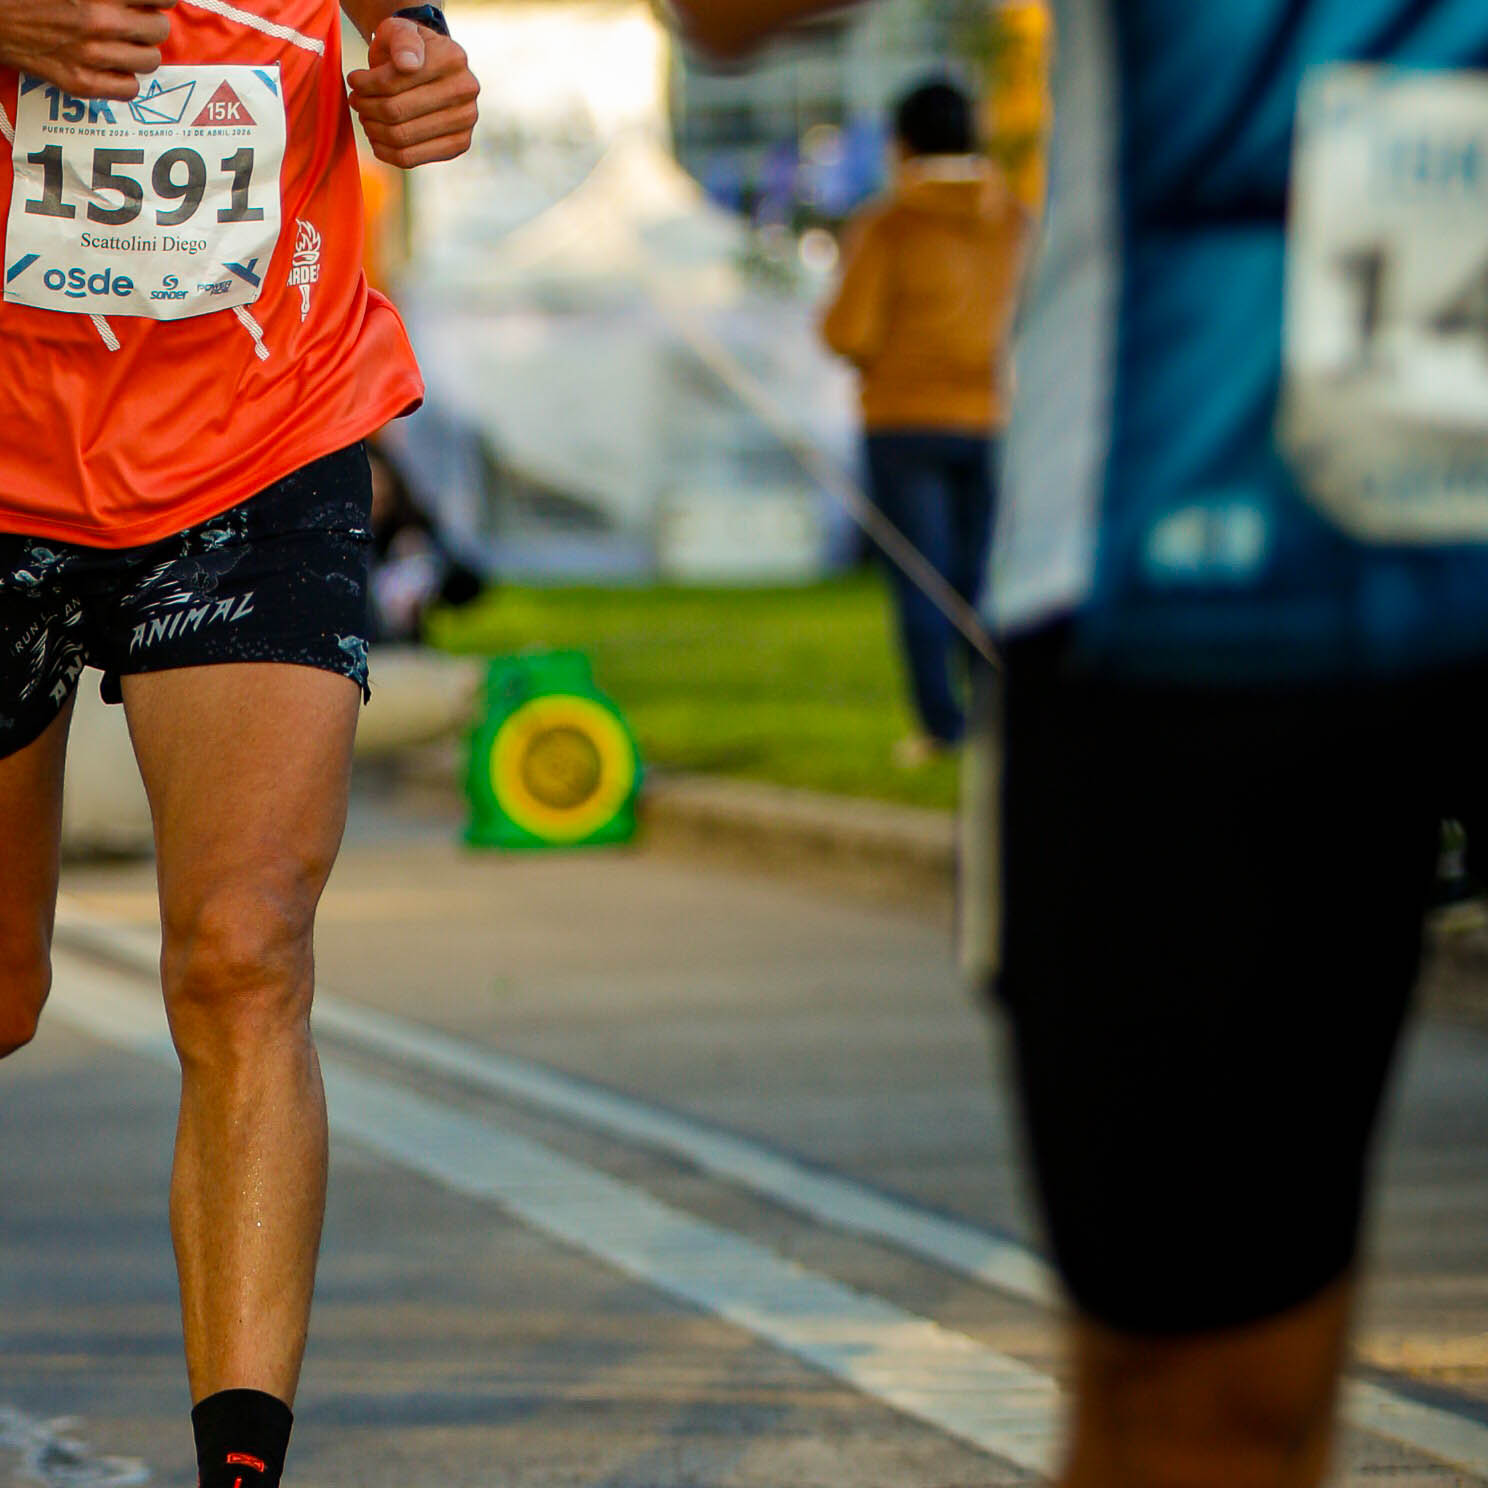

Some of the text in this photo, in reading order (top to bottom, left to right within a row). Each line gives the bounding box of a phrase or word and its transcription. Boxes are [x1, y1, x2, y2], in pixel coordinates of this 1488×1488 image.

[206, 102, 241, 121] 15K
[42, 125, 76, 135] PUERTO
[78, 128, 106, 137] NORTE
[138, 129, 174, 137] ROSARIO
[194, 129, 204, 137] DE
[207, 129, 229, 137] ABRIL
[24, 144, 265, 227] 1591
[80, 232, 207, 255] Scattolini Diego
[43, 267, 135, 298] osde
[129, 592, 254, 655] ANIMAL
